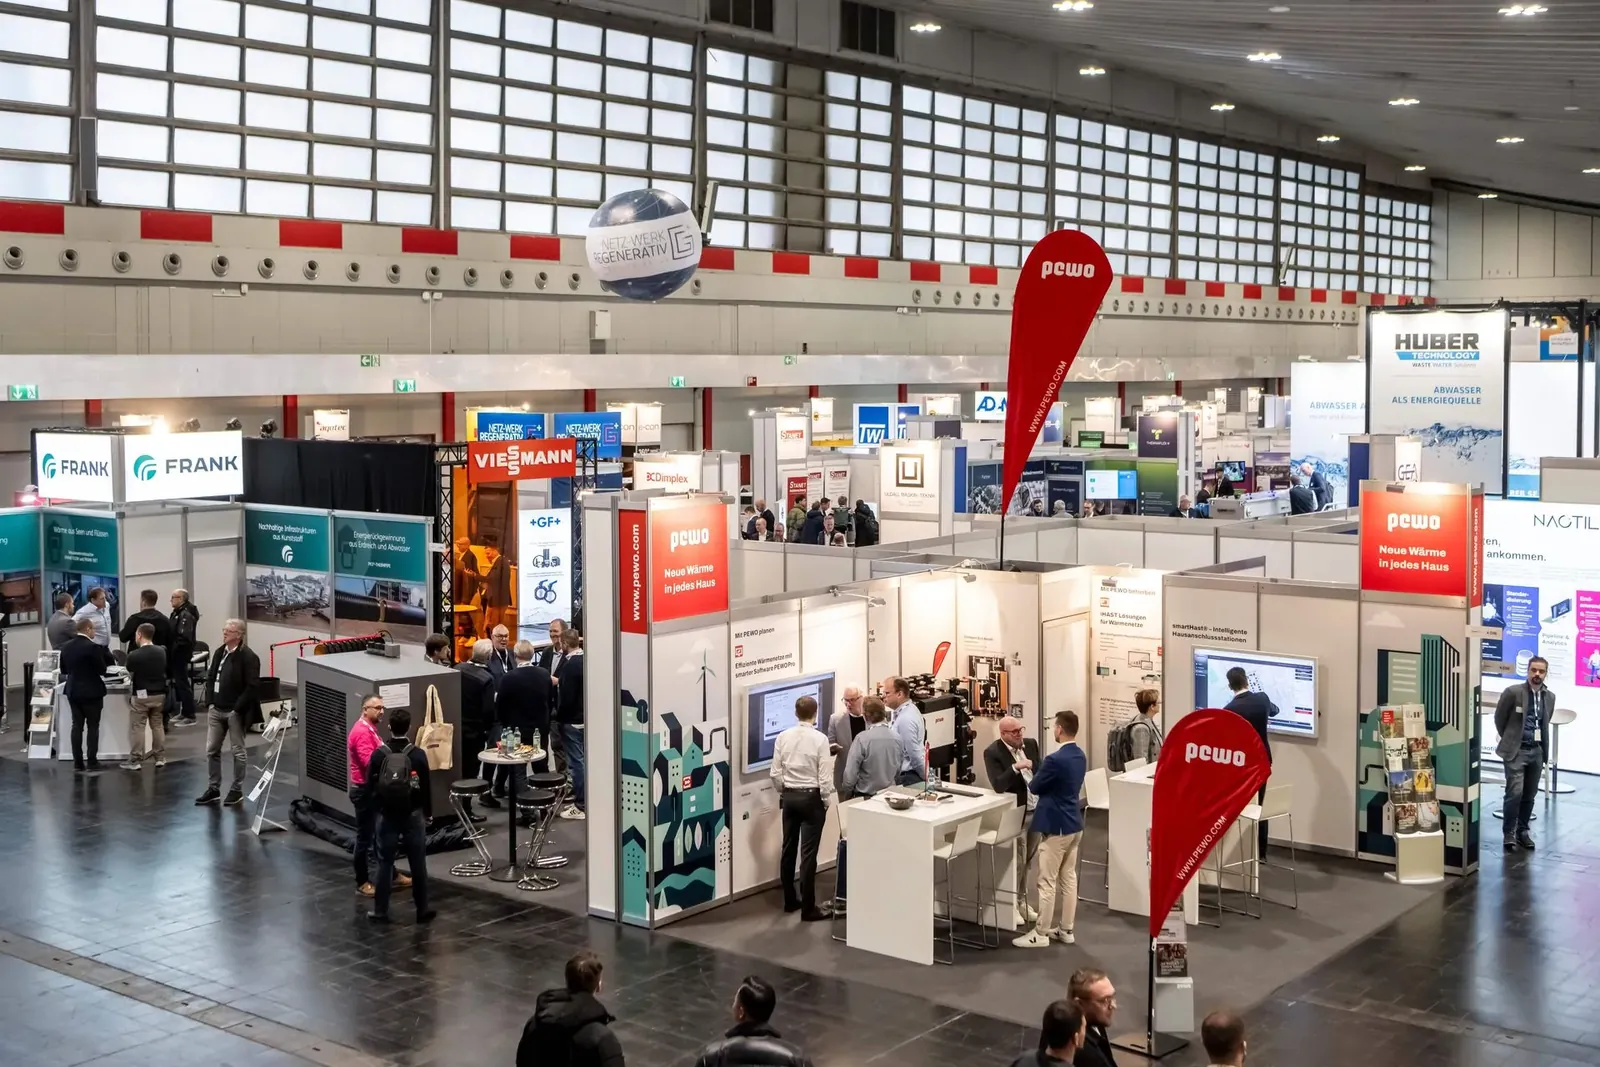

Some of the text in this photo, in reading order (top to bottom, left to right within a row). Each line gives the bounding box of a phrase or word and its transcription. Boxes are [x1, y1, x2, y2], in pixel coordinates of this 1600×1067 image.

[602, 231, 667, 250] NETZ-WERK
[1395, 333, 1479, 350] HUBER
[1029, 360, 1068, 433] WWW.PEWO.COM
[1434, 386, 1482, 394] ABWASSER
[1309, 401, 1358, 410] ABWASSER
[1391, 396, 1482, 405] ALS ENERGIEQUELLE
[488, 423, 523, 432] NETZ-WERK
[566, 423, 601, 432] NETZ-WERK
[165, 455, 238, 474] FRANK
[474, 445, 573, 476] VIESSMANN
[61, 459, 109, 477] FRANK
[656, 473, 688, 484] Dimplex
[53, 526, 67, 534] Wärme
[258, 522, 317, 535] Nachhaltige Infrastrukturen
[281, 534, 304, 542] Kunststoff
[354, 530, 406, 544] Energierückgewinnung
[358, 540, 376, 549] Erdreich
[377, 543, 387, 551] und
[388, 544, 411, 553] Abwasser
[1379, 545, 1447, 558] Neue Wärme
[1486, 550, 1547, 562] ankommen.
[664, 564, 714, 578] Neue Wärme
[1379, 558, 1449, 572] in jedes Haus
[632, 524, 641, 620] www.pewo.com
[664, 578, 716, 595] in jedes Haus
[1109, 620, 1144, 628] Wärmenetze
[743, 629, 759, 637] PEWO
[759, 627, 775, 636] planen
[1172, 631, 1247, 643] Hausanschlussstationen
[1213, 627, 1248, 636] Intelligente
[735, 660, 757, 669] Effiziente
[757, 654, 785, 665] Wärmenetze
[735, 669, 754, 679] smarter
[754, 666, 774, 675] Software
[1177, 815, 1227, 881] WWW.PEWO.COM
